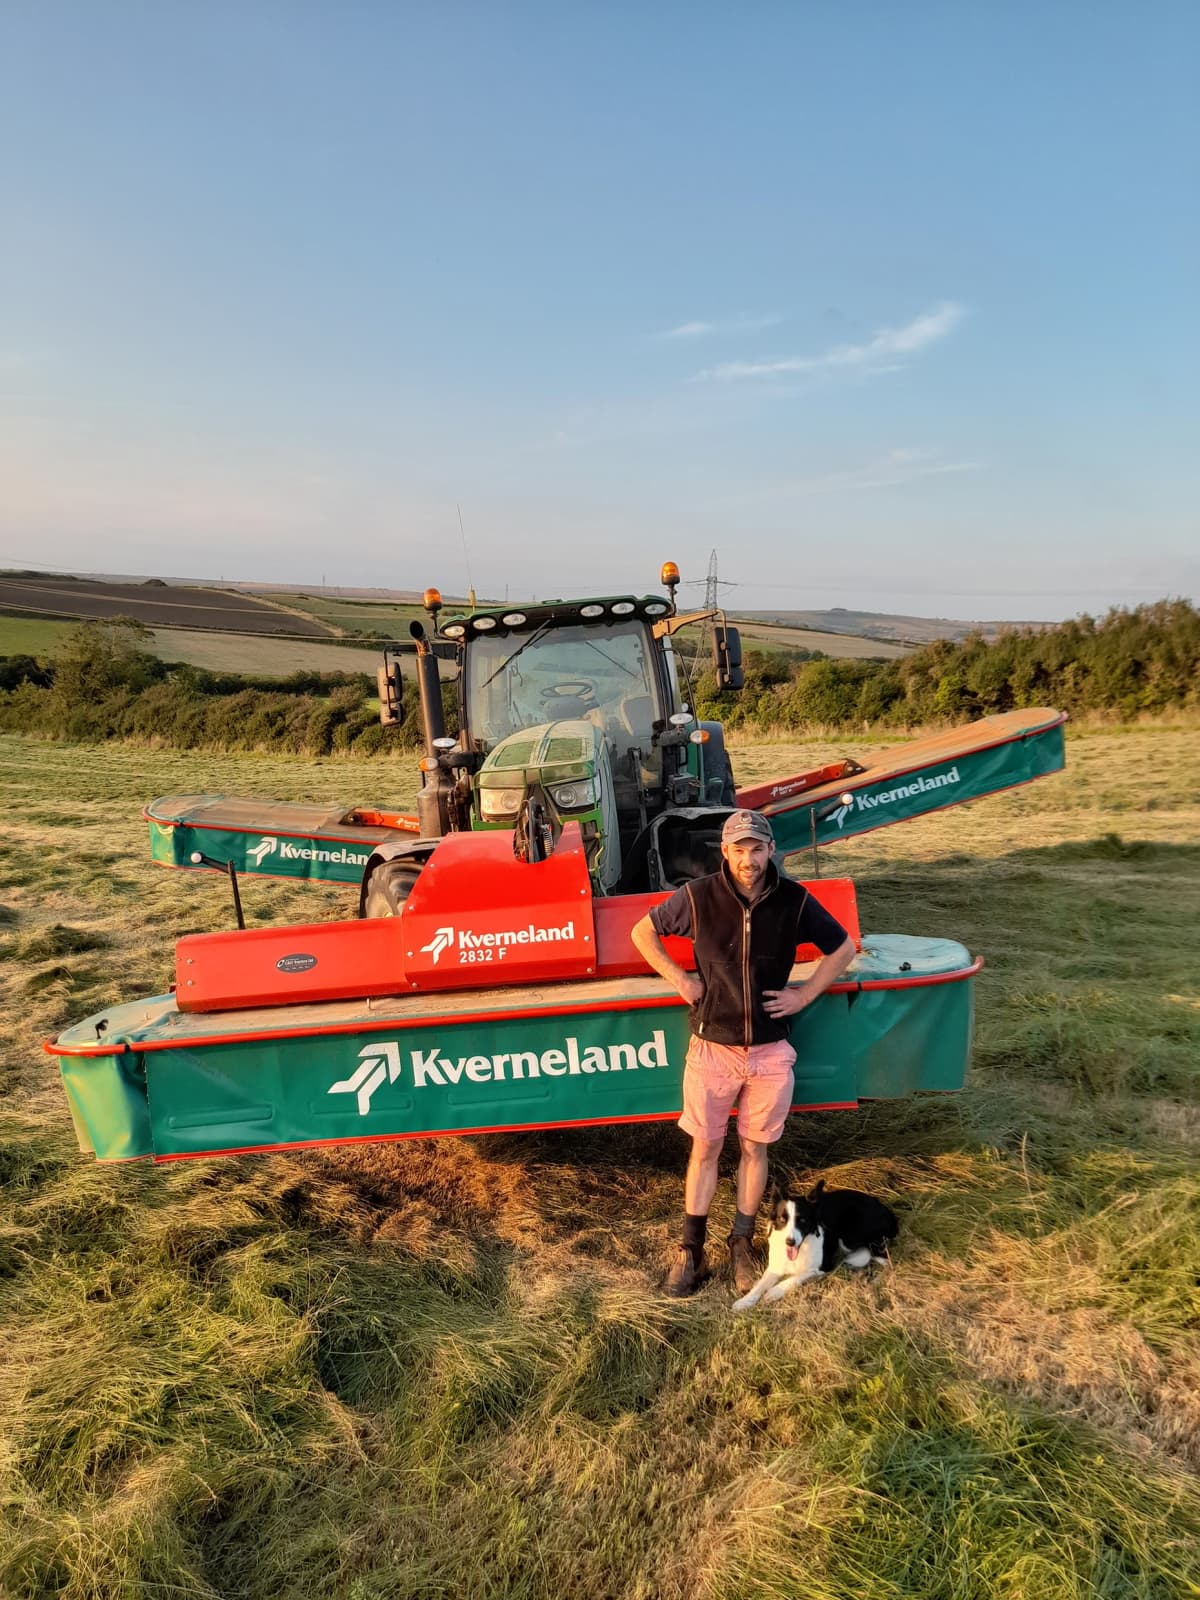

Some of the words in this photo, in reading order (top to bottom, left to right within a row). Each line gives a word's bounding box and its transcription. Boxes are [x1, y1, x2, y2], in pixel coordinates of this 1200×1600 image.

[855, 766, 960, 811] Kverneland
[280, 842, 370, 866] Kvernelan
[458, 921, 575, 949] Kverneland
[459, 949, 493, 964] 2832
[499, 947, 507, 960] F
[410, 1030, 669, 1087] Kverneland
